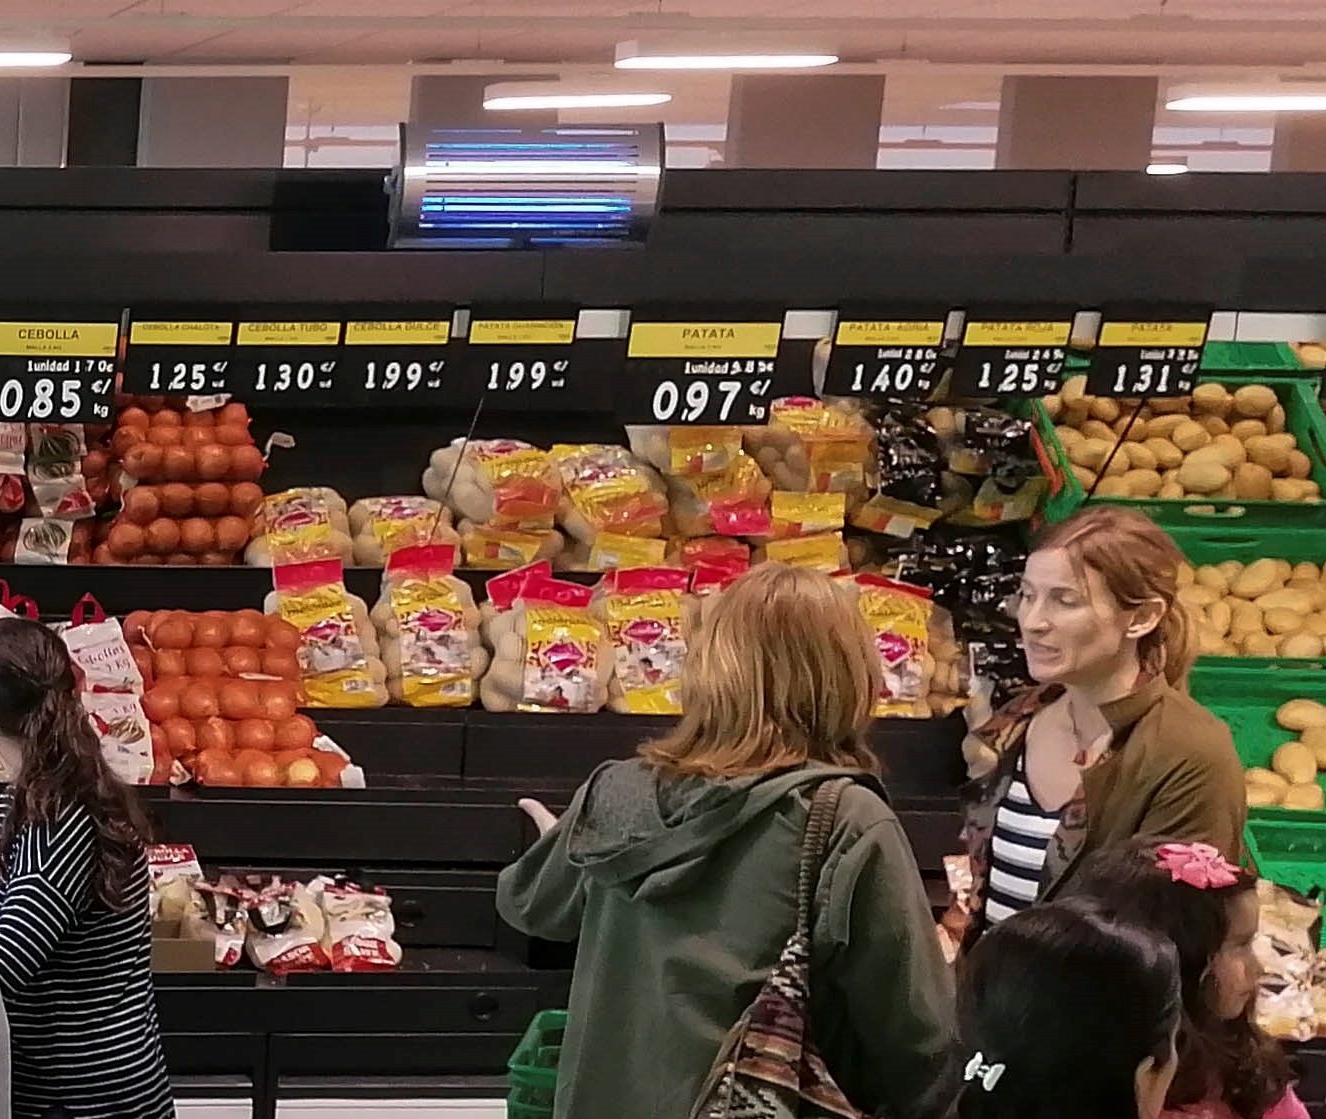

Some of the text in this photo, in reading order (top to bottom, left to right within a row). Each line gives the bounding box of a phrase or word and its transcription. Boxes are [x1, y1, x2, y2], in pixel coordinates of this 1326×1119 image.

[18, 328, 80, 340] CEBOLLA
[248, 324, 296, 332] CEBOLLA
[682, 328, 735, 339] PATATA
[27, 360, 69, 372] 1unidad
[150, 362, 206, 391] 1,25
[255, 362, 315, 391] 1,30
[365, 362, 421, 390] 1,99
[488, 362, 545, 390] 1,99
[979, 362, 1039, 392] 1,25
[1113, 364, 1169, 392] 1,31
[0, 378, 82, 418] 0,85
[93, 403, 109, 418] kg
[653, 380, 741, 422] 0,97
[749, 404, 765, 420] kg
